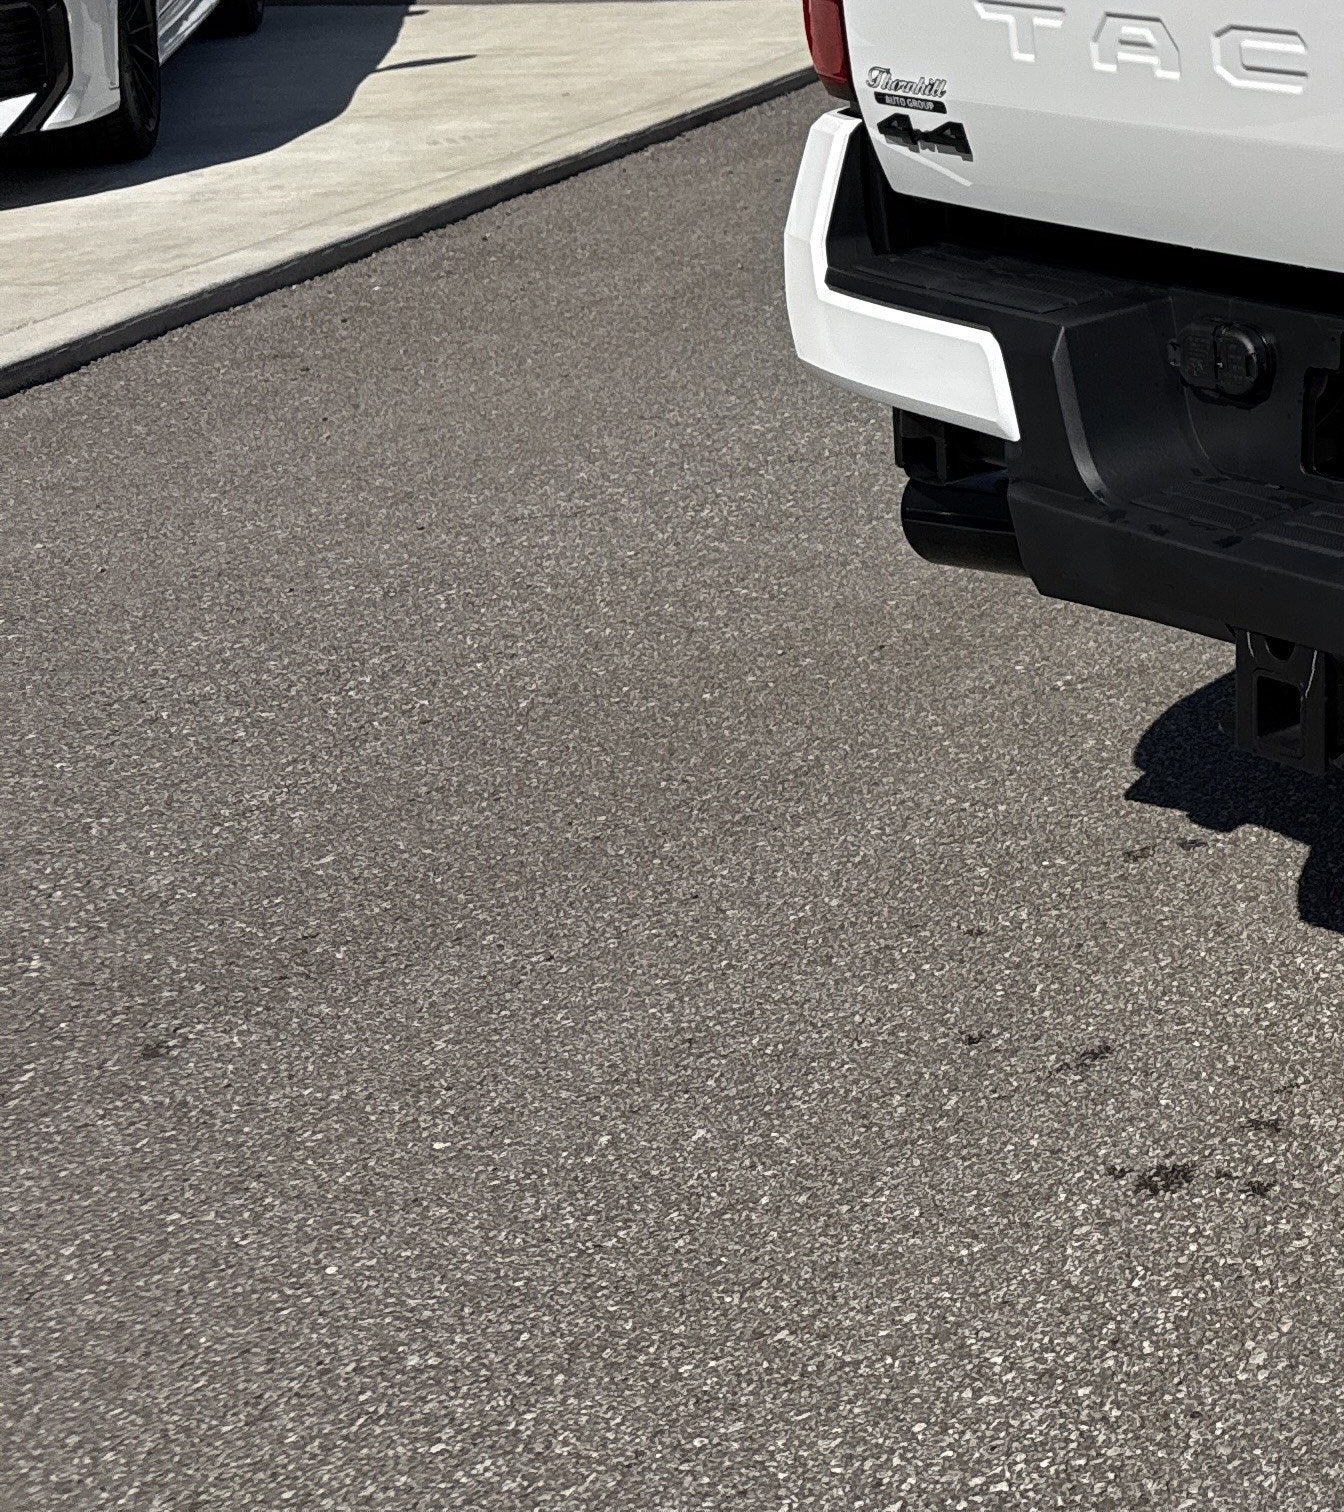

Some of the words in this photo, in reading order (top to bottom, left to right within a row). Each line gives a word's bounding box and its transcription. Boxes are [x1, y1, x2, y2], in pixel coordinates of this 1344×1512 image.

[866, 66, 947, 98] Thornhill
[885, 94, 906, 106] AUTO
[907, 97, 934, 110] GROUP
